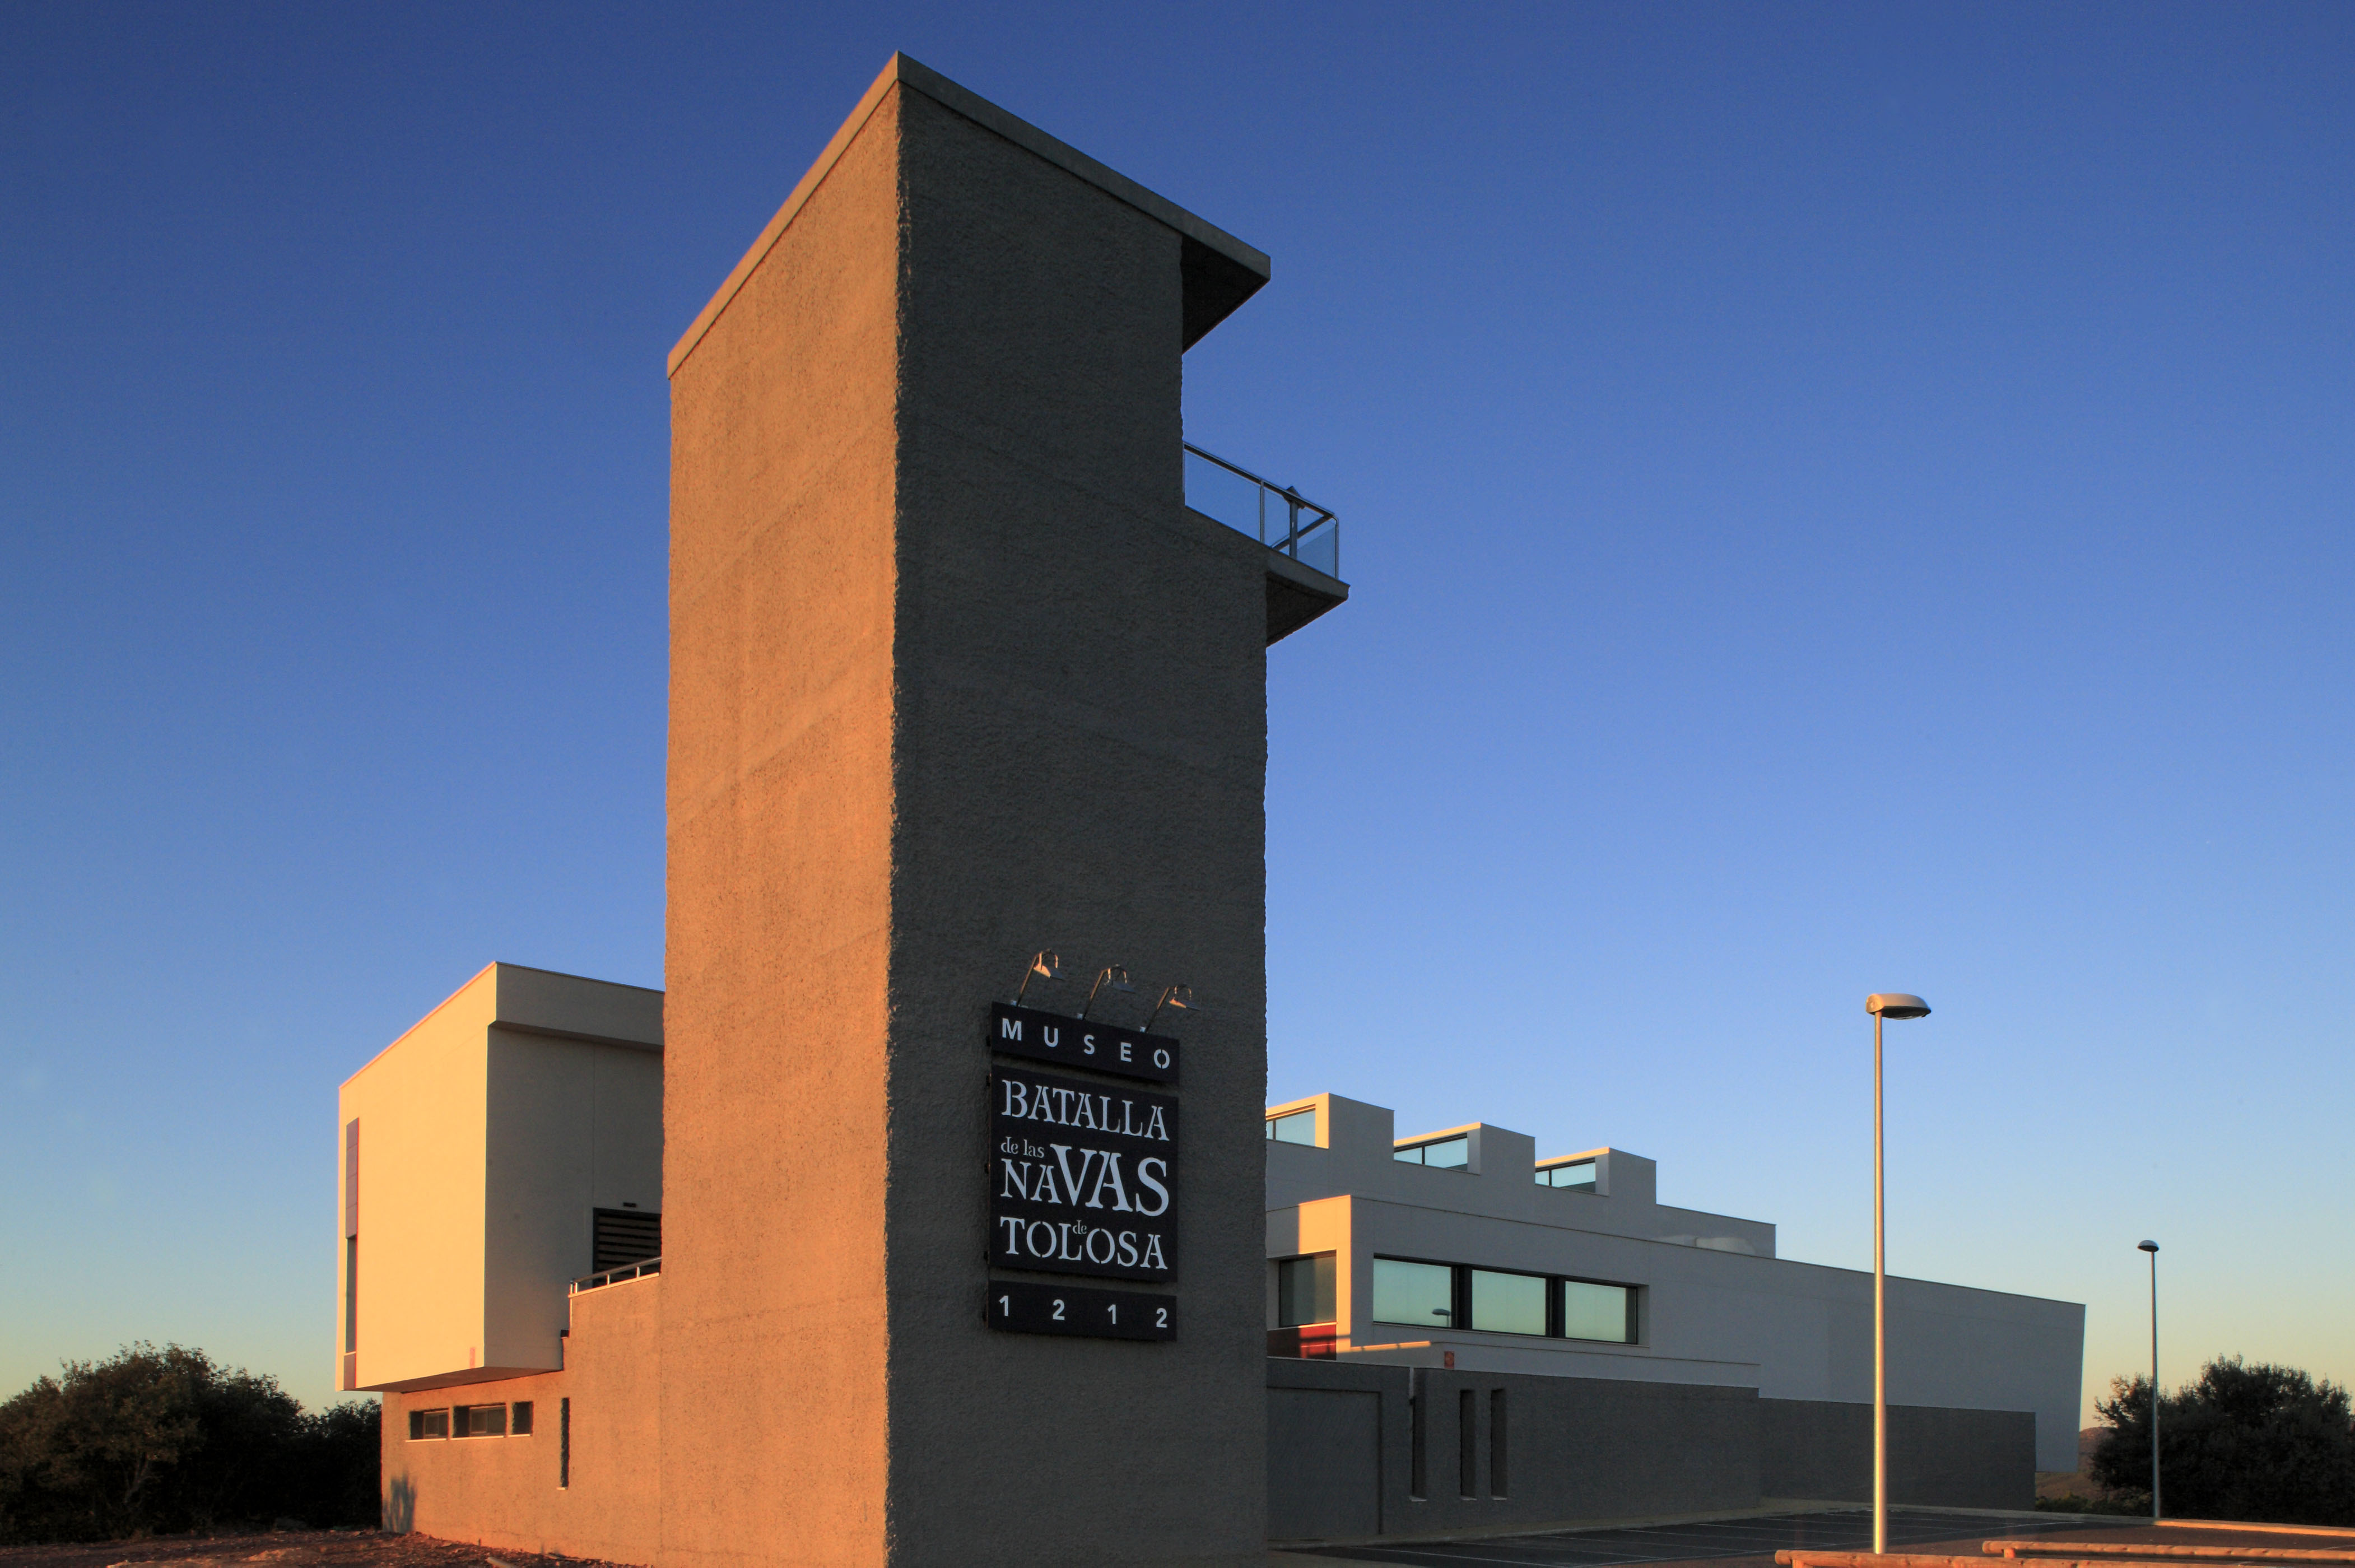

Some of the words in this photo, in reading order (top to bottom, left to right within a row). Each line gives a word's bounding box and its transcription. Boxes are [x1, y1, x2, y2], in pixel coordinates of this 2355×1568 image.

[1002, 1017, 1170, 1069] MUSEO
[1001, 1079, 1170, 1141] BATALLA
[1000, 1136, 1018, 1155] de
[1023, 1139, 1045, 1158] las
[1000, 1143, 1170, 1217] NAVAS
[1000, 1216, 1168, 1269] TOLOSA
[1072, 1220, 1087, 1235] de
[999, 1295, 1168, 1328] 1212
